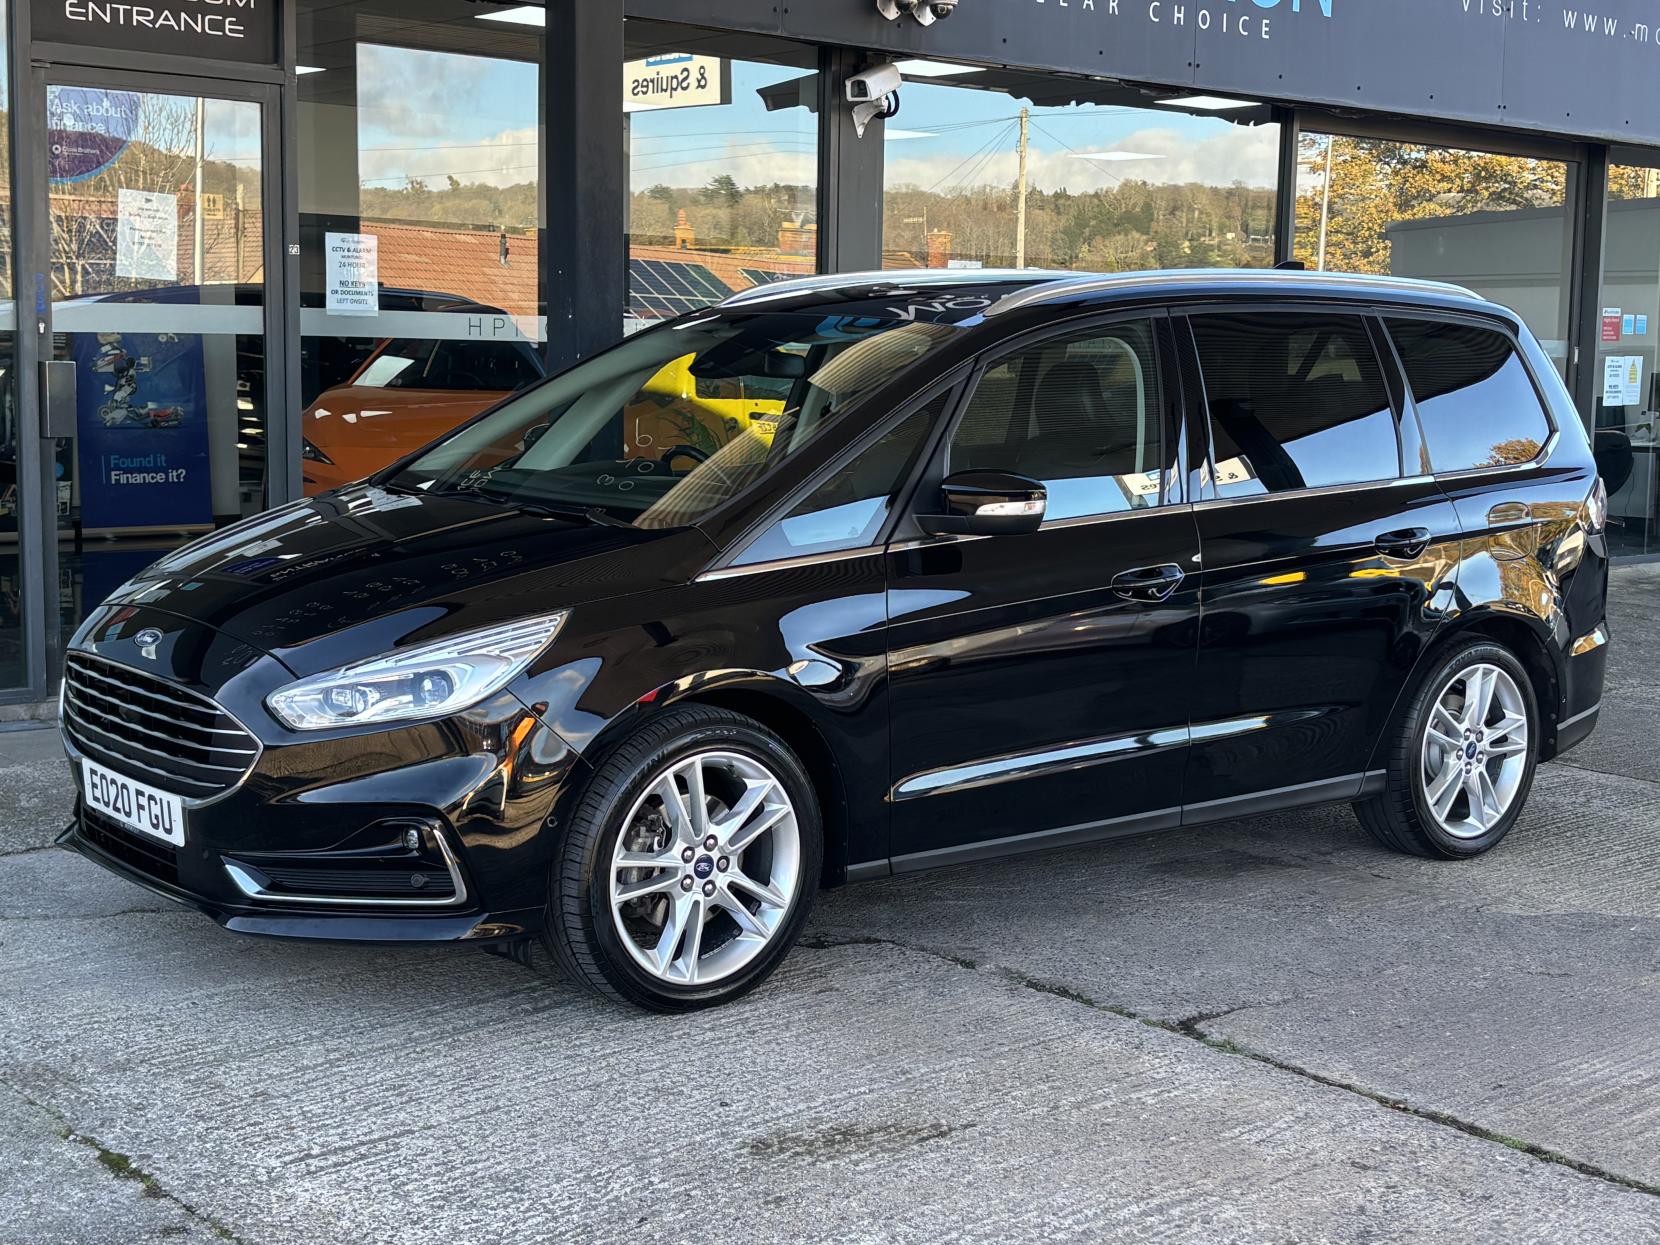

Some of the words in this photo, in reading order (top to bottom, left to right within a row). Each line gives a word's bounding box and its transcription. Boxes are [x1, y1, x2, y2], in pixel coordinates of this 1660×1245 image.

[65, 0, 245, 38] ENTRANCE
[1149, 2, 1270, 38] CHOICE
[53, 99, 80, 114] Ask
[84, 101, 126, 118] about
[468, 316, 519, 337] HPI
[110, 454, 154, 468] Found
[156, 454, 167, 467] it
[111, 470, 166, 484] Finance
[168, 468, 186, 483] it?
[135, 788, 173, 836] FGU
